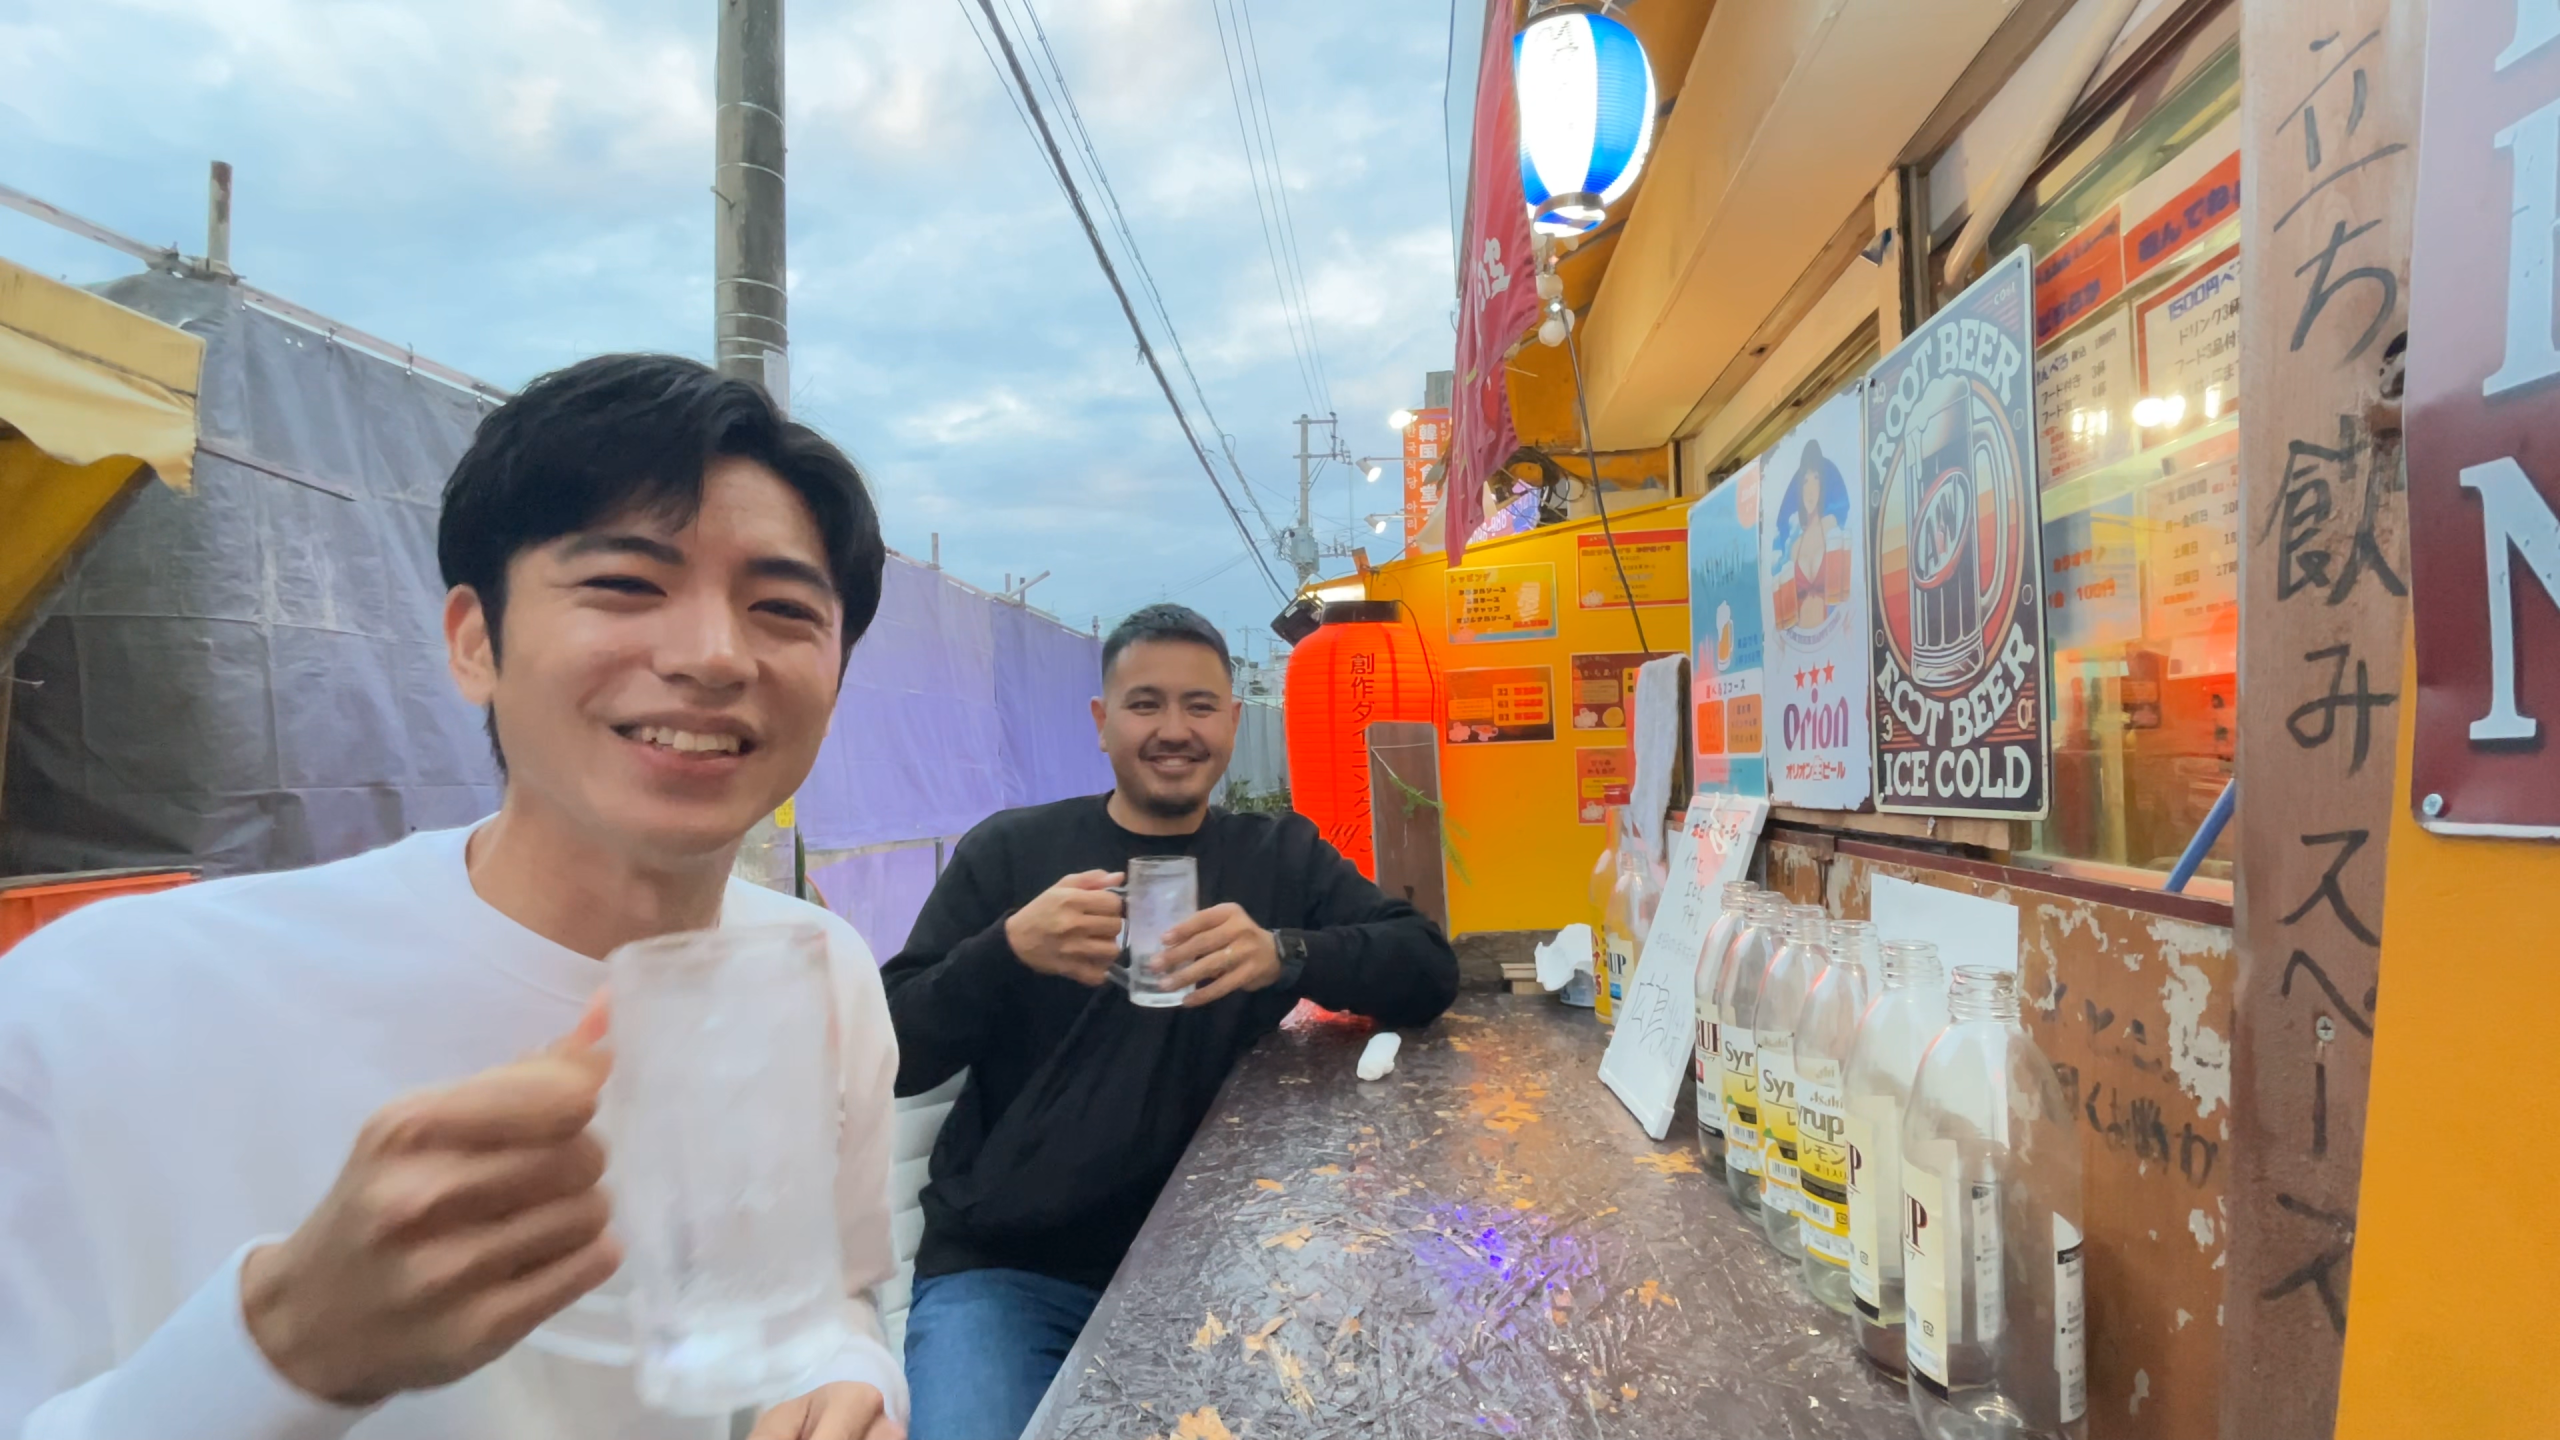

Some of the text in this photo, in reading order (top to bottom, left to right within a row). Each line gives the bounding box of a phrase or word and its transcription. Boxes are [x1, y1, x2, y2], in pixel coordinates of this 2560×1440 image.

[1870, 336, 1933, 485] ROOT
[1937, 319, 2022, 406] BEER
[1783, 687, 1850, 752] Orion
[1950, 622, 2036, 748] BEER
[2256, 30, 2408, 1336] 立ち飲みスペース
[1884, 745, 2032, 798] ICE COLD
[1802, 1137, 1847, 1166] レモン
